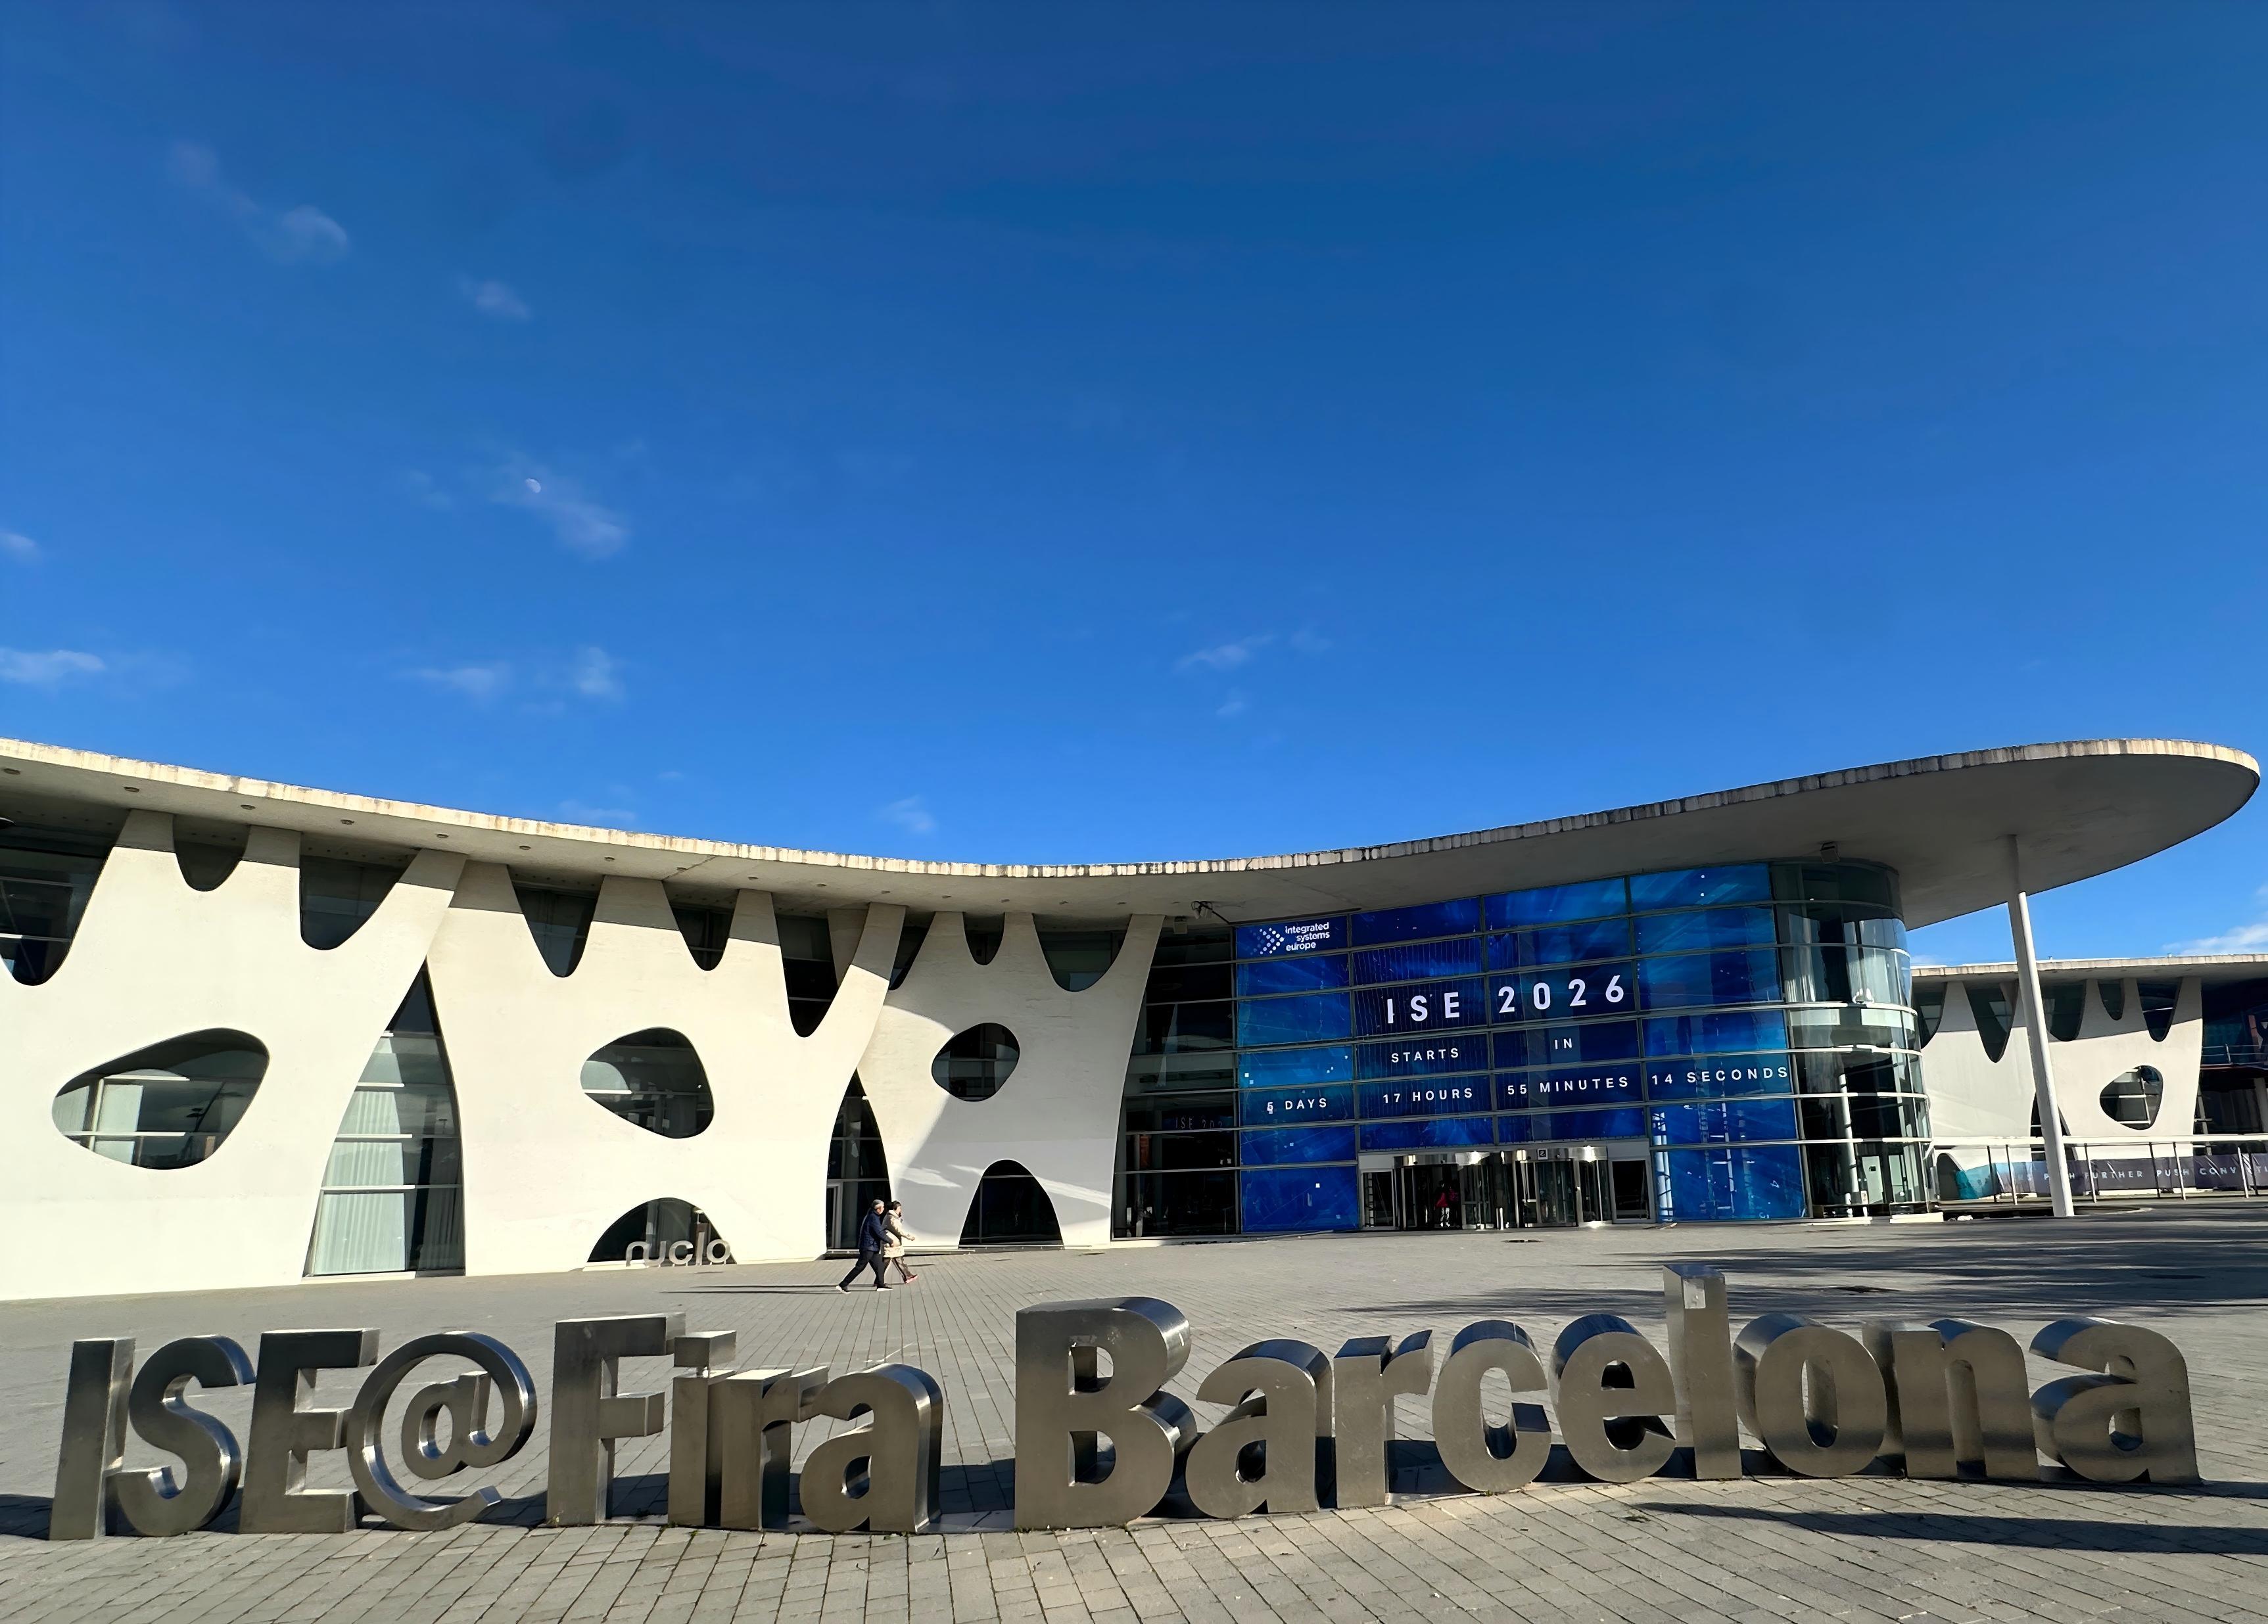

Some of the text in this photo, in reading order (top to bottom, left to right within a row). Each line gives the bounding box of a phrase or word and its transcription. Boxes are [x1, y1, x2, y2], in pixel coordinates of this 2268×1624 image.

[1285, 922, 1329, 934] integrated
[1296, 931, 1331, 942] systems
[1285, 941, 1317, 952] europe
[1386, 975, 1624, 1024] ISE 2026
[1390, 1038, 1572, 1063] STARTS IN
[1285, 1098, 1327, 1110] DAYS
[1382, 1093, 1401, 1103] 17
[1412, 1087, 1473, 1102] HOURS
[1507, 1084, 1527, 1096] 55
[1540, 1077, 1628, 1093] MINUTES
[1651, 1073, 1673, 1085] 14
[1686, 1066, 1788, 1083] SECONDS
[2156, 1169, 2190, 1177] PUSH
[625, 1232, 731, 1267] nuclo
[49, 1264, 2202, 1541] ISE@Fira Barcelona
